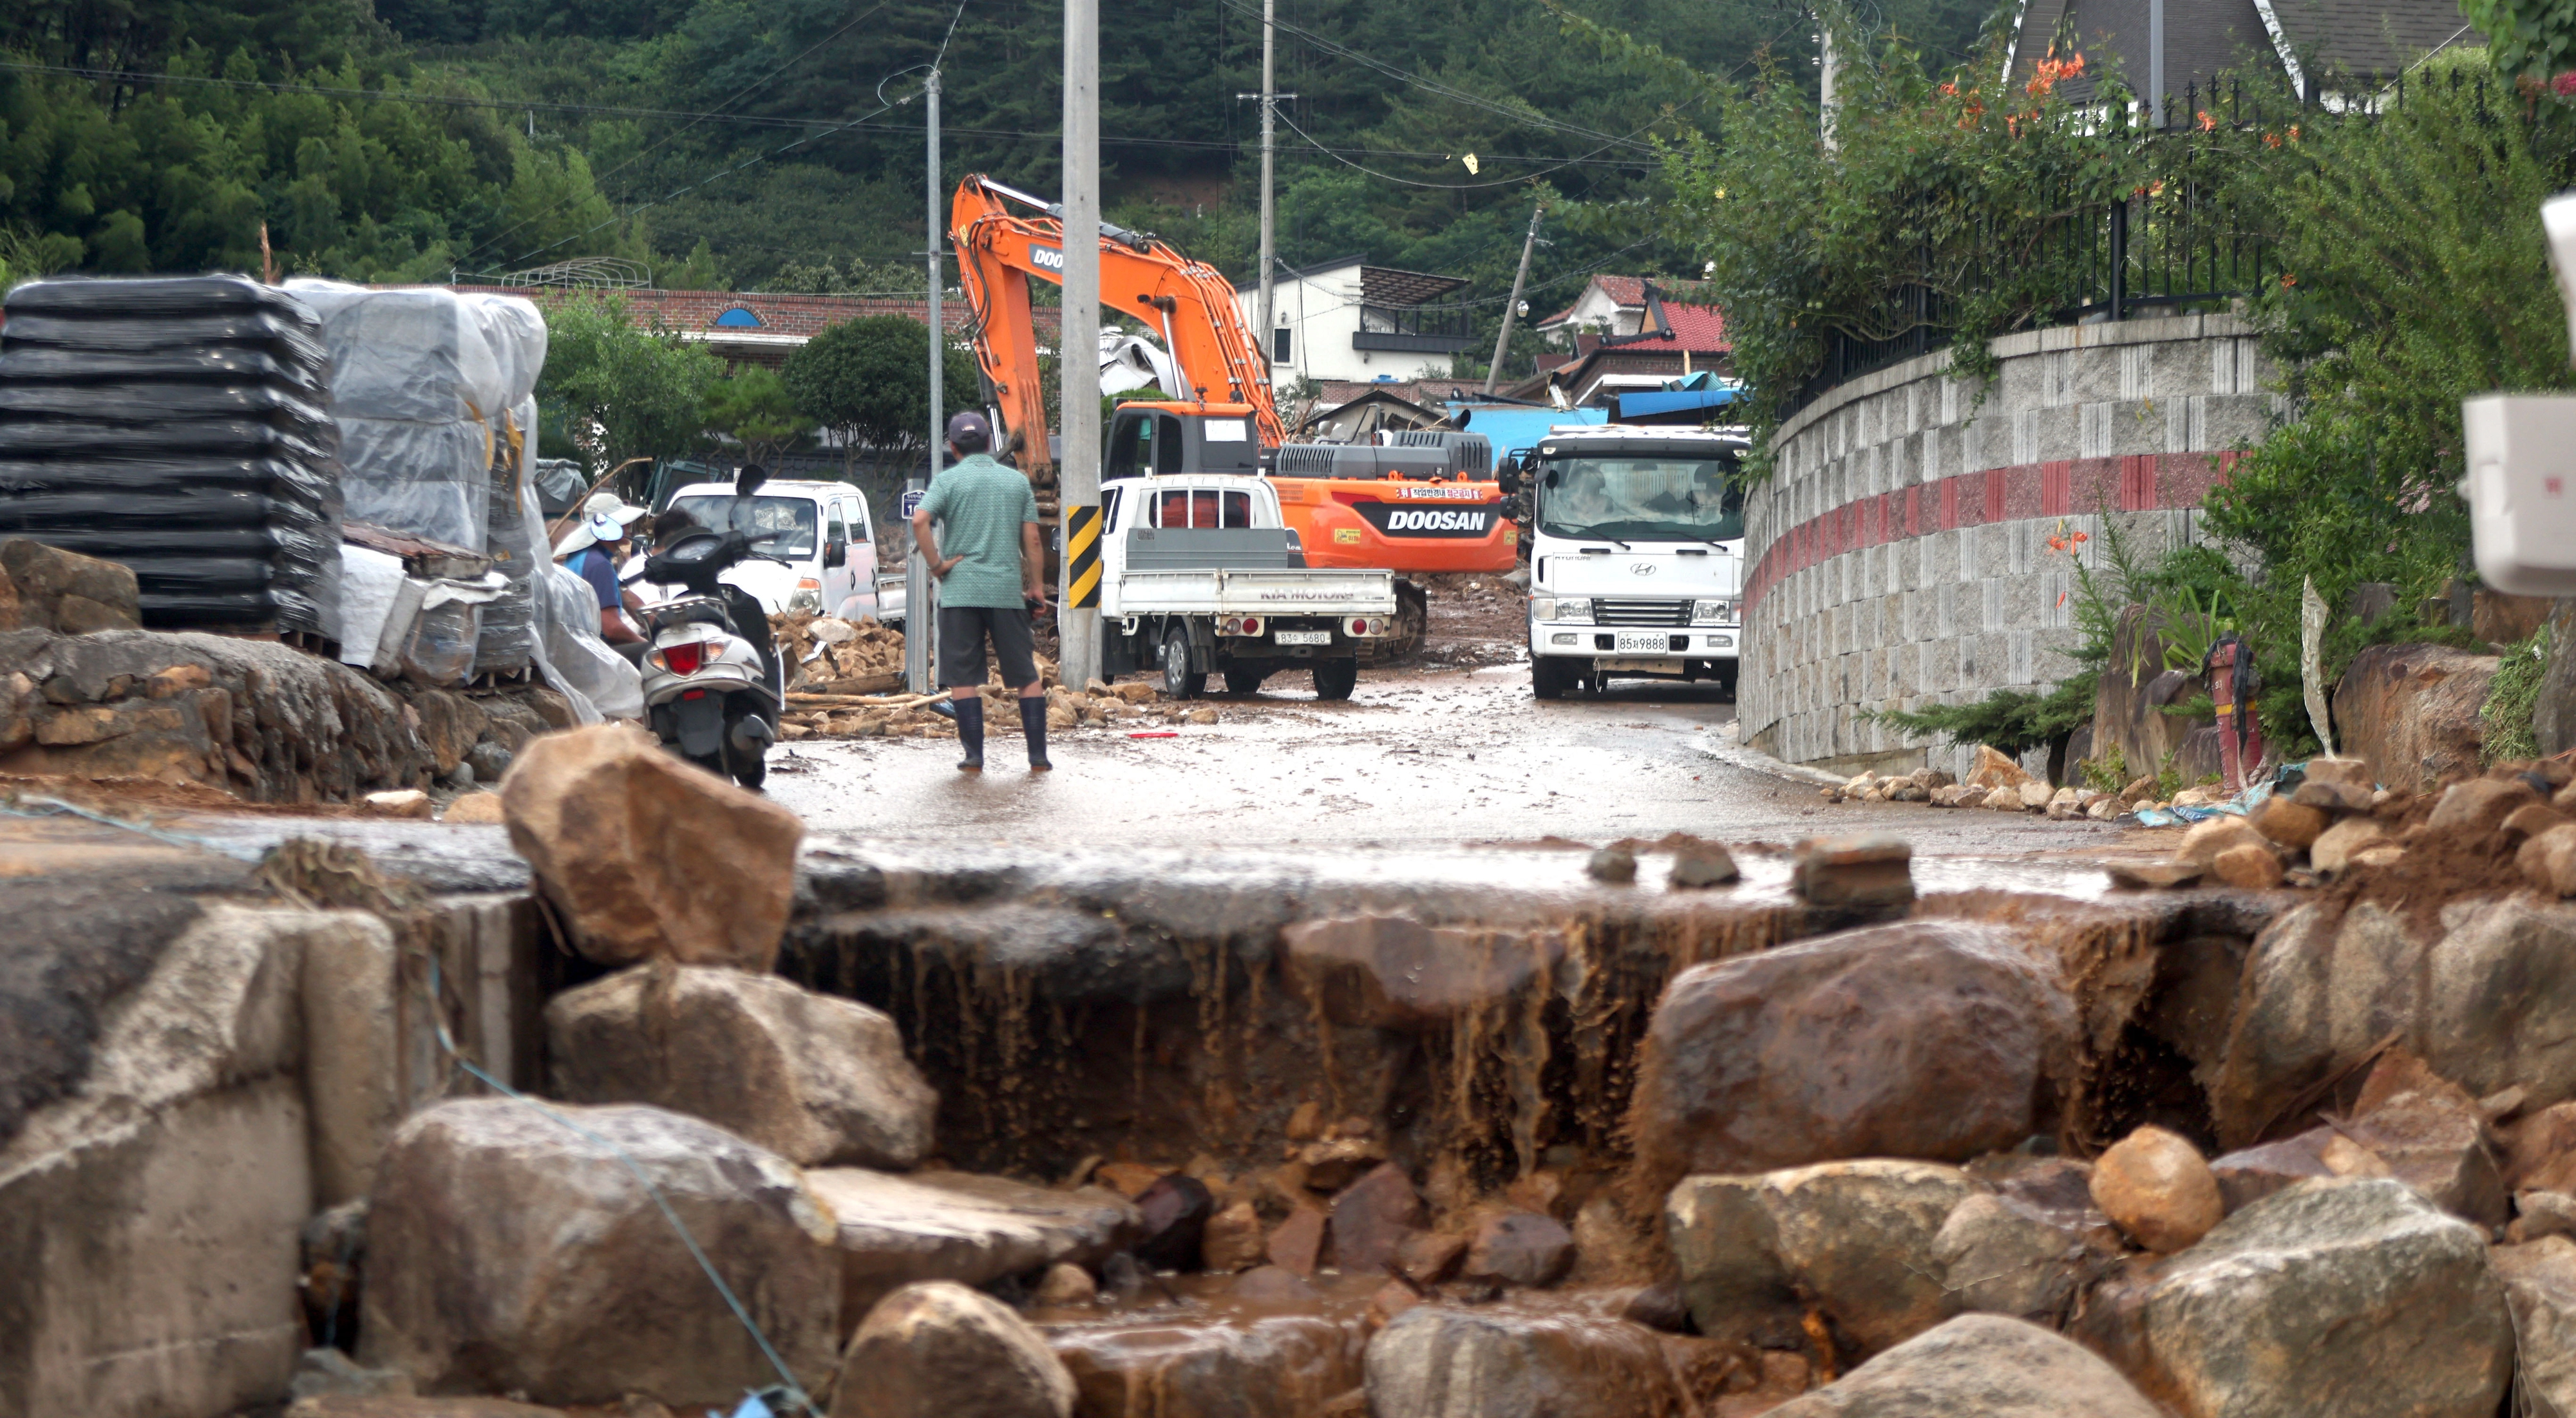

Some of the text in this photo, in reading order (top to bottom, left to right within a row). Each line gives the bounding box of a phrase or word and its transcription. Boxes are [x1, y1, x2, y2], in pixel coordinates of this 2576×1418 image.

[1401, 489, 1408, 497] 위
[1413, 489, 1446, 497] 작업반경내
[1446, 489, 1470, 498] 접근금지
[1387, 511, 1486, 531] DOOSAN
[1260, 589, 1287, 600] KIA
[1281, 634, 1325, 643] 83수 5680
